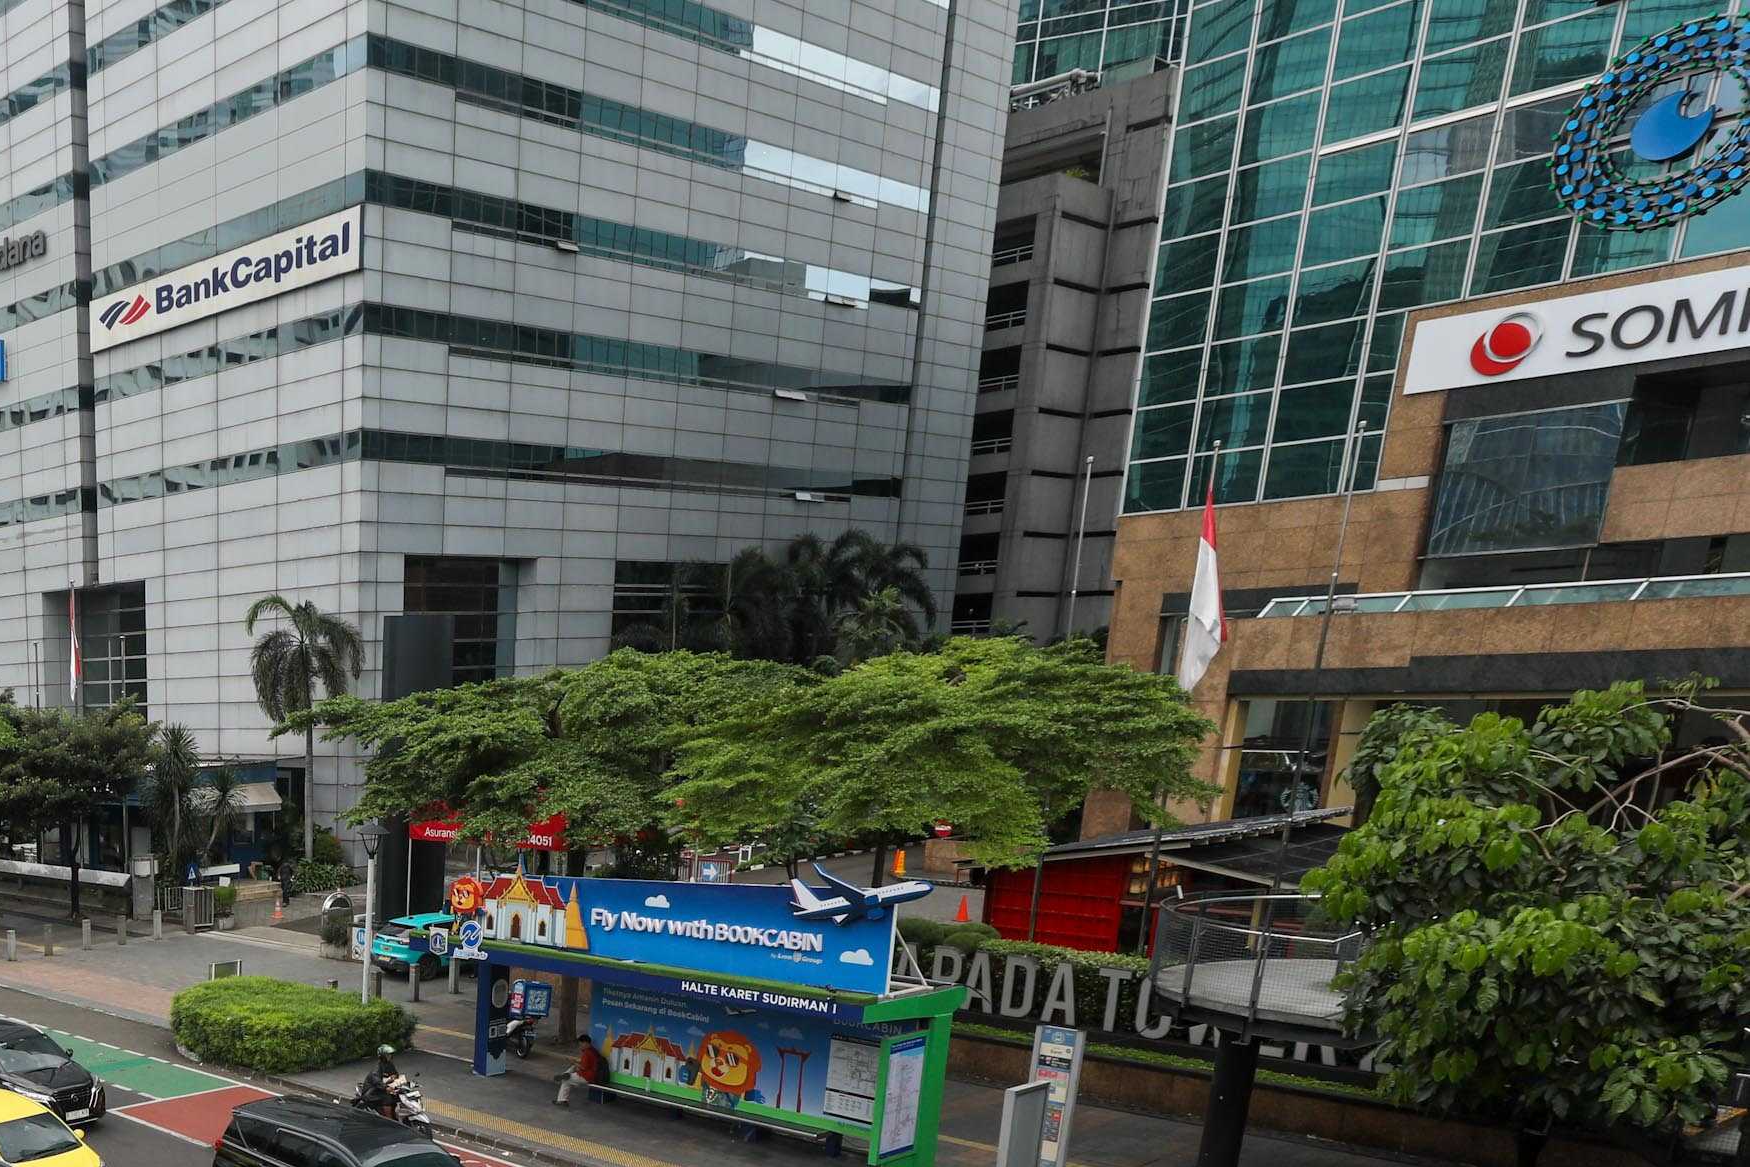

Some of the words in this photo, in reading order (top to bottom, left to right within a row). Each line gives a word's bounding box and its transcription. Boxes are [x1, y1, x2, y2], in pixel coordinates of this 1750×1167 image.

[155, 221, 350, 314] BankCapital
[591, 908, 619, 932] Fly
[620, 911, 667, 934] Now
[667, 919, 714, 941] with
[714, 923, 824, 953] BOOKCABIN
[681, 980, 717, 997] HALTE
[720, 986, 759, 1002] KARET
[762, 994, 829, 1014] SUDIRMAN
